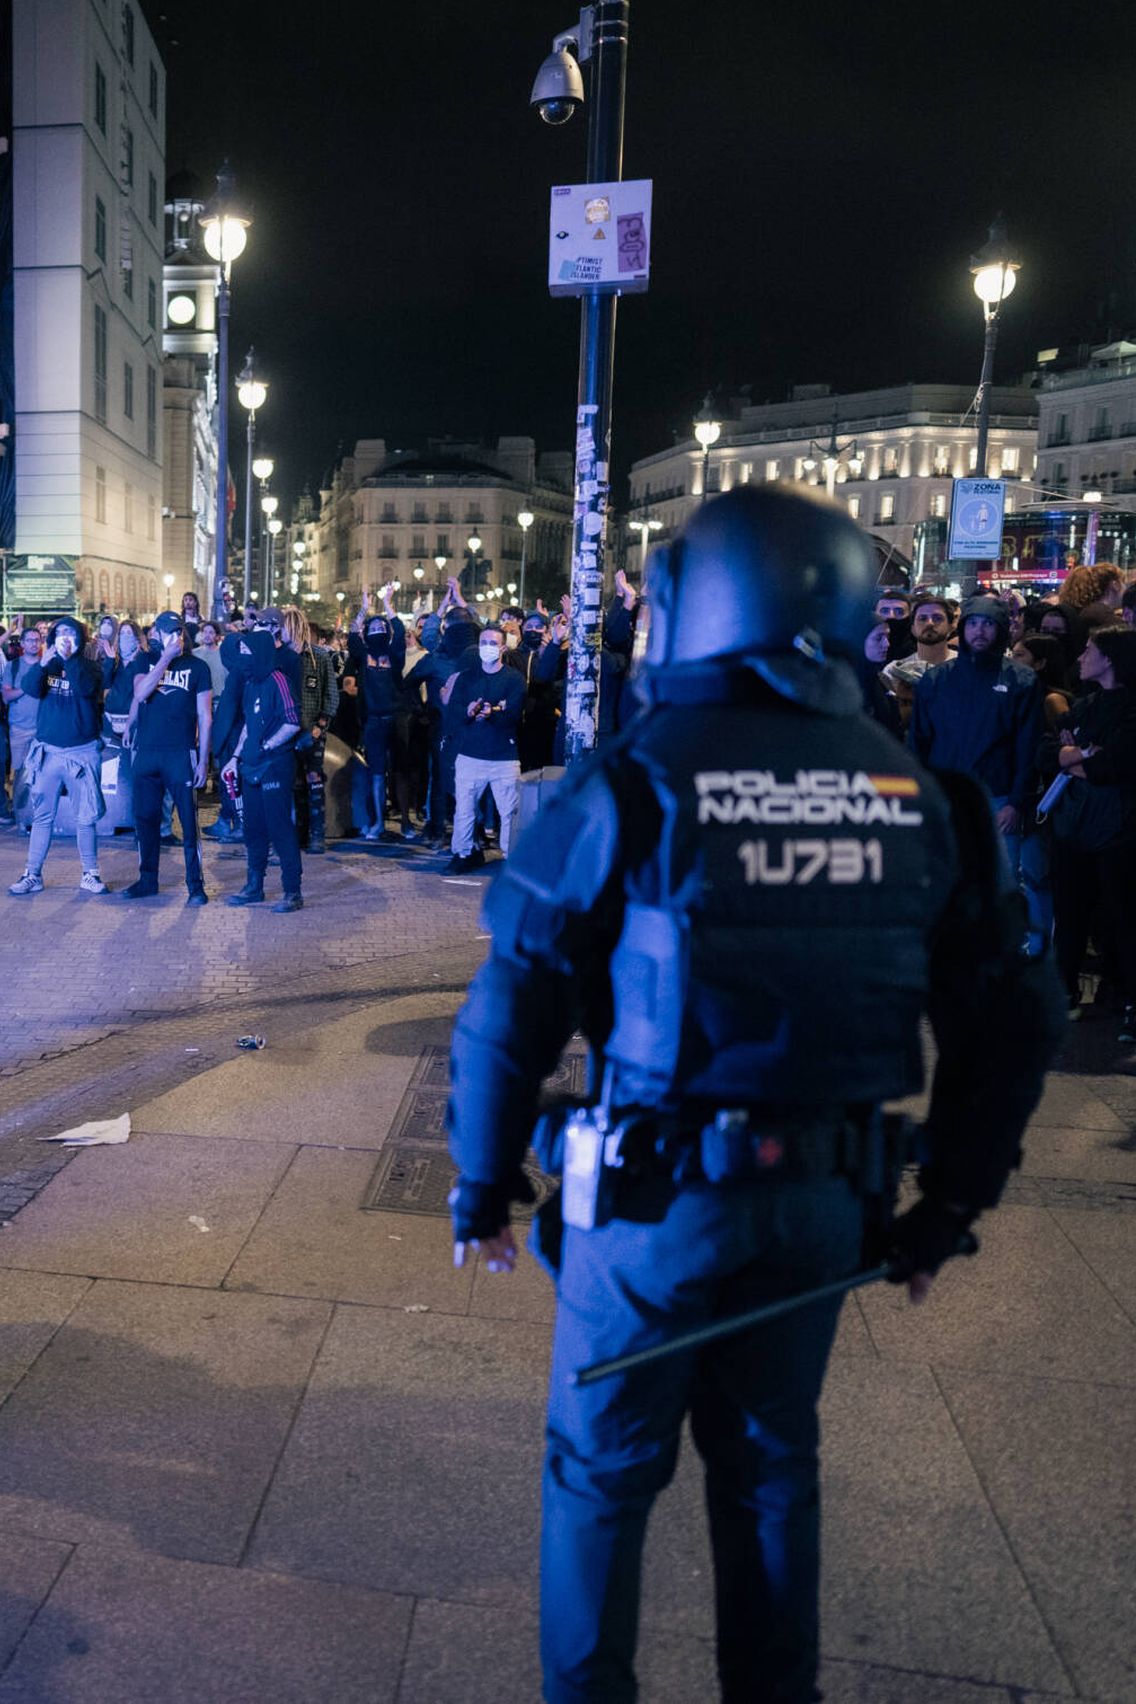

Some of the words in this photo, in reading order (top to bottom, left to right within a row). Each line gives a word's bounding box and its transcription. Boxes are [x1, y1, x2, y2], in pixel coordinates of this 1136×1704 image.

[149, 664, 191, 690] LAST
[695, 769, 878, 797] POLICIA
[698, 794, 924, 827] NACIONAL
[737, 838, 883, 885] 1U731
